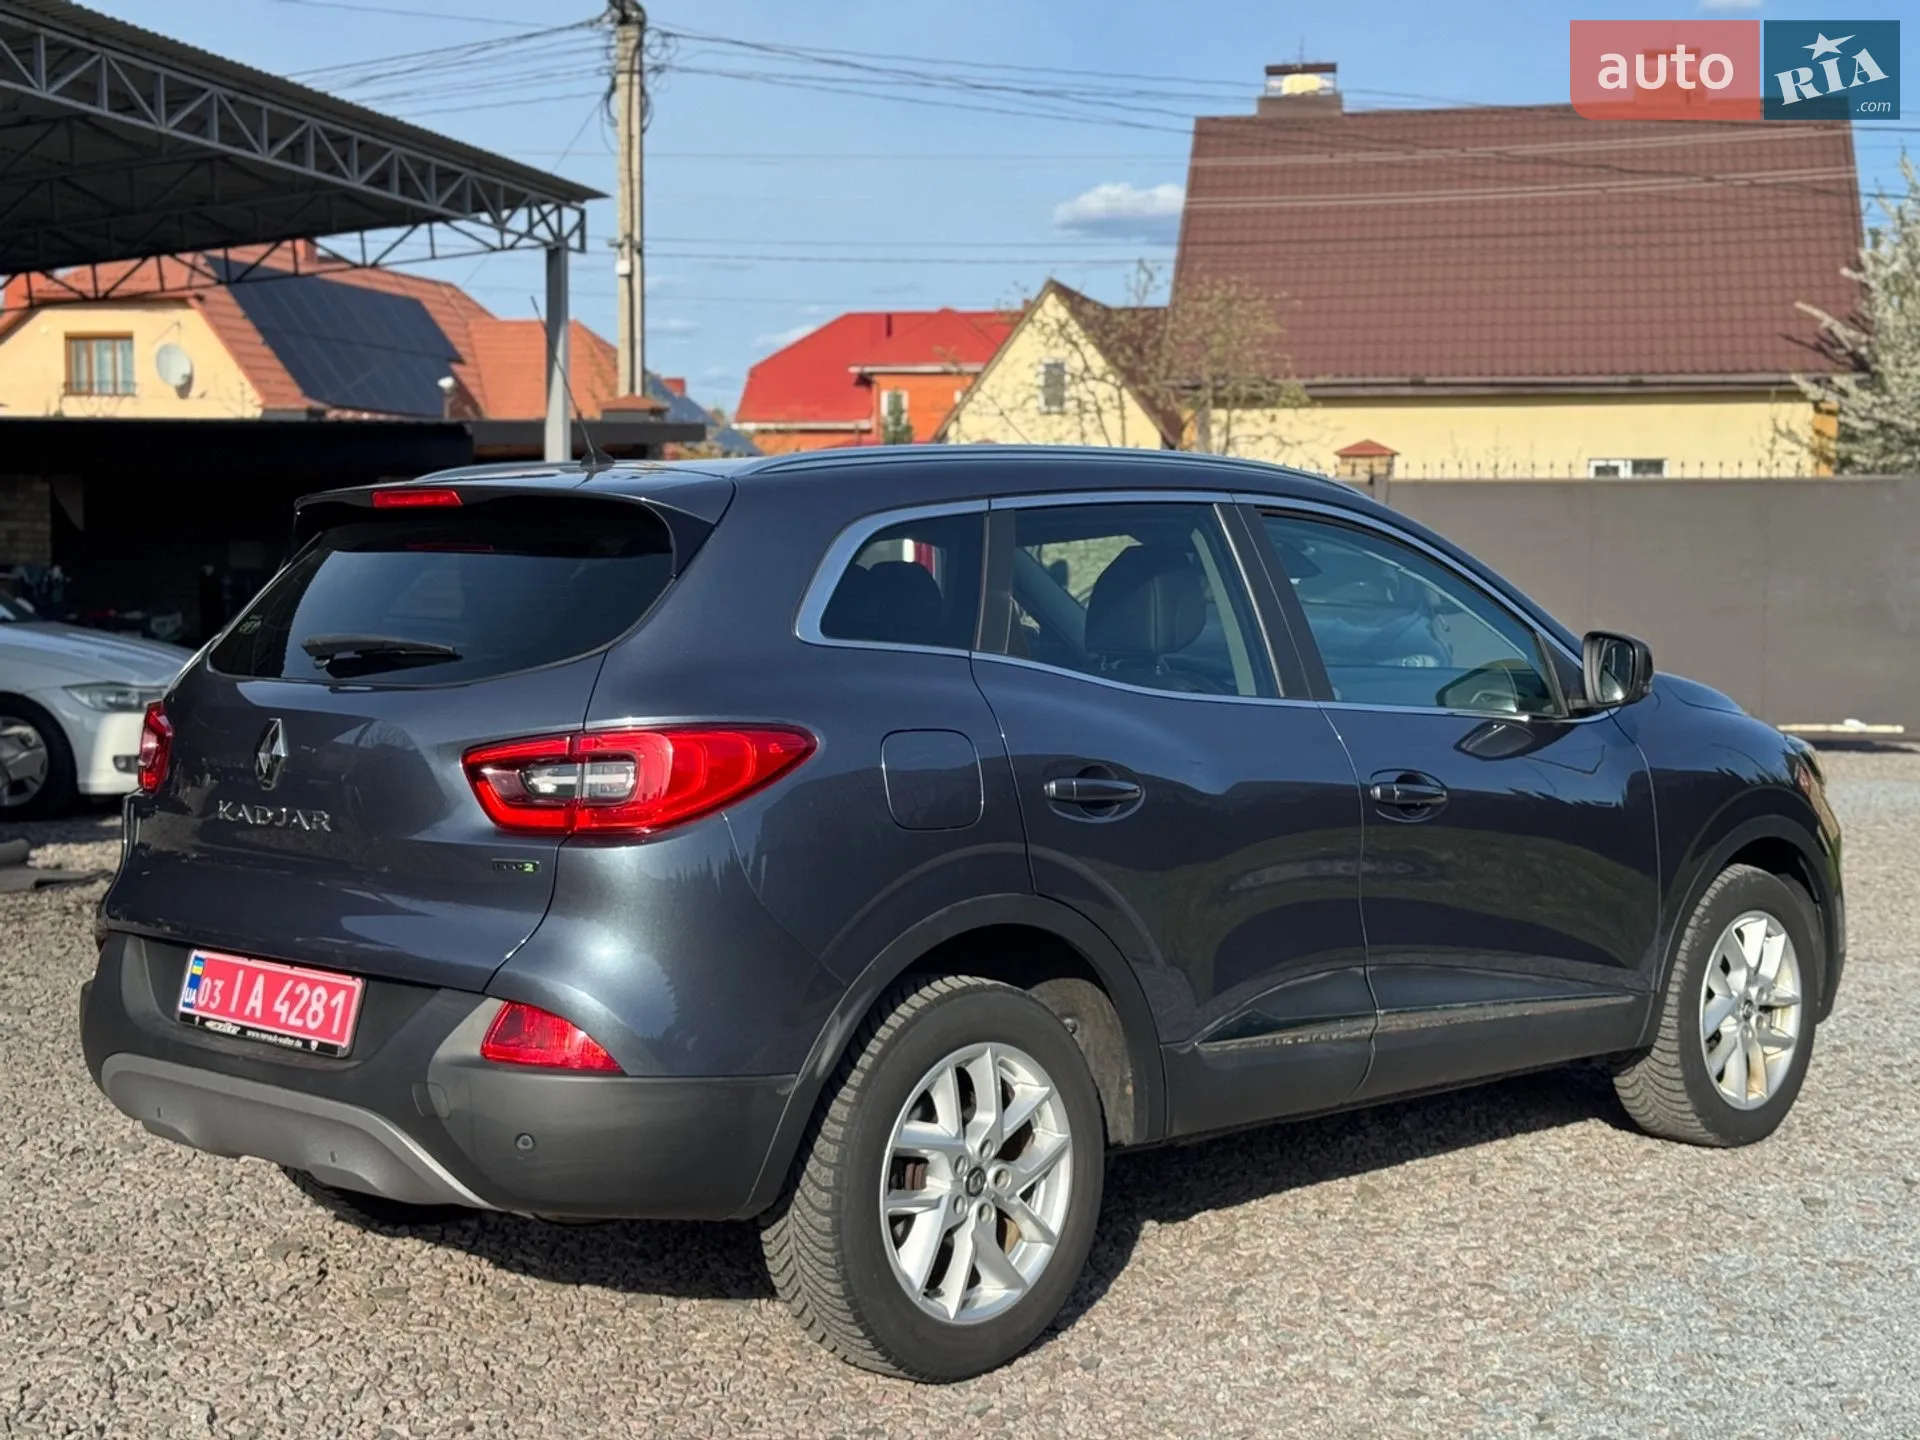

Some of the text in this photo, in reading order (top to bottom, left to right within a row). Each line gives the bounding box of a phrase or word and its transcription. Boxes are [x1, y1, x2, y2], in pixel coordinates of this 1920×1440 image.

[218, 800, 332, 832] KADJAR
[184, 987, 197, 1004] UA
[198, 976, 225, 1010] 03
[273, 979, 347, 1035] 4281
